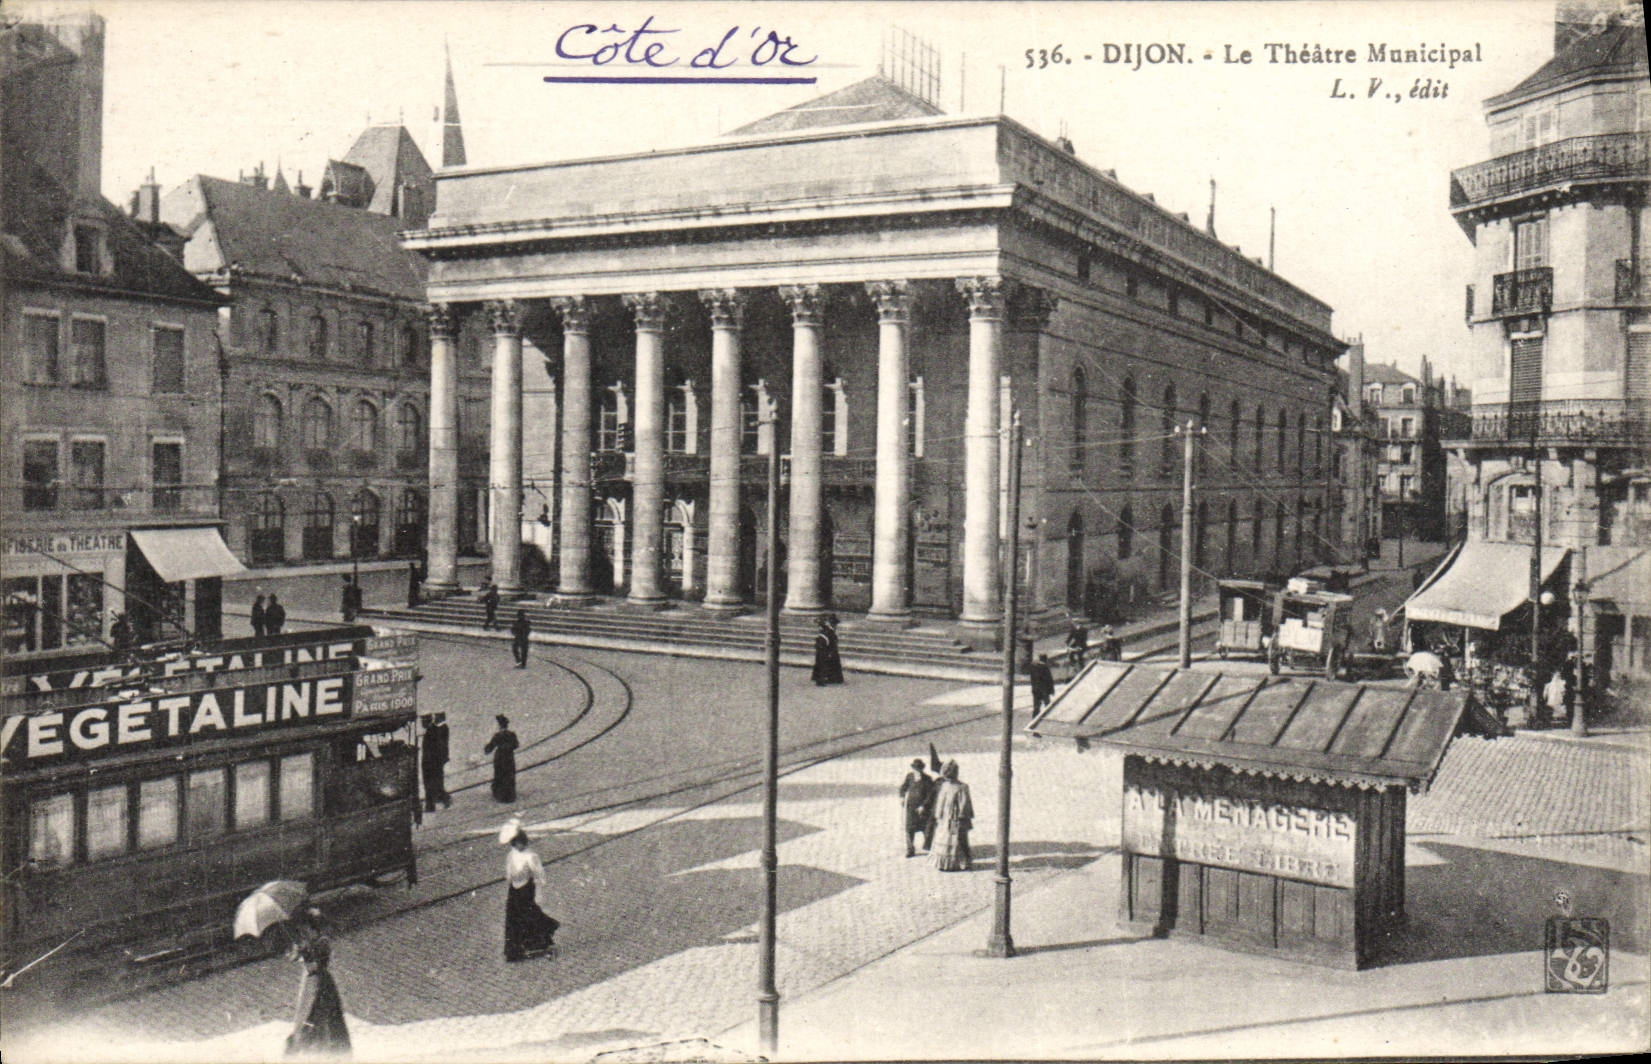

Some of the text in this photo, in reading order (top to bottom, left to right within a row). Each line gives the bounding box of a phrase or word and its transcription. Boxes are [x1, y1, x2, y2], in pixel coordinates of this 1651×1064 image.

[555, 15, 818, 69] Côte d'Or
[355, 672, 390, 687] GRAND
[391, 695, 413, 710] 1900
[1127, 788, 1144, 811] A
